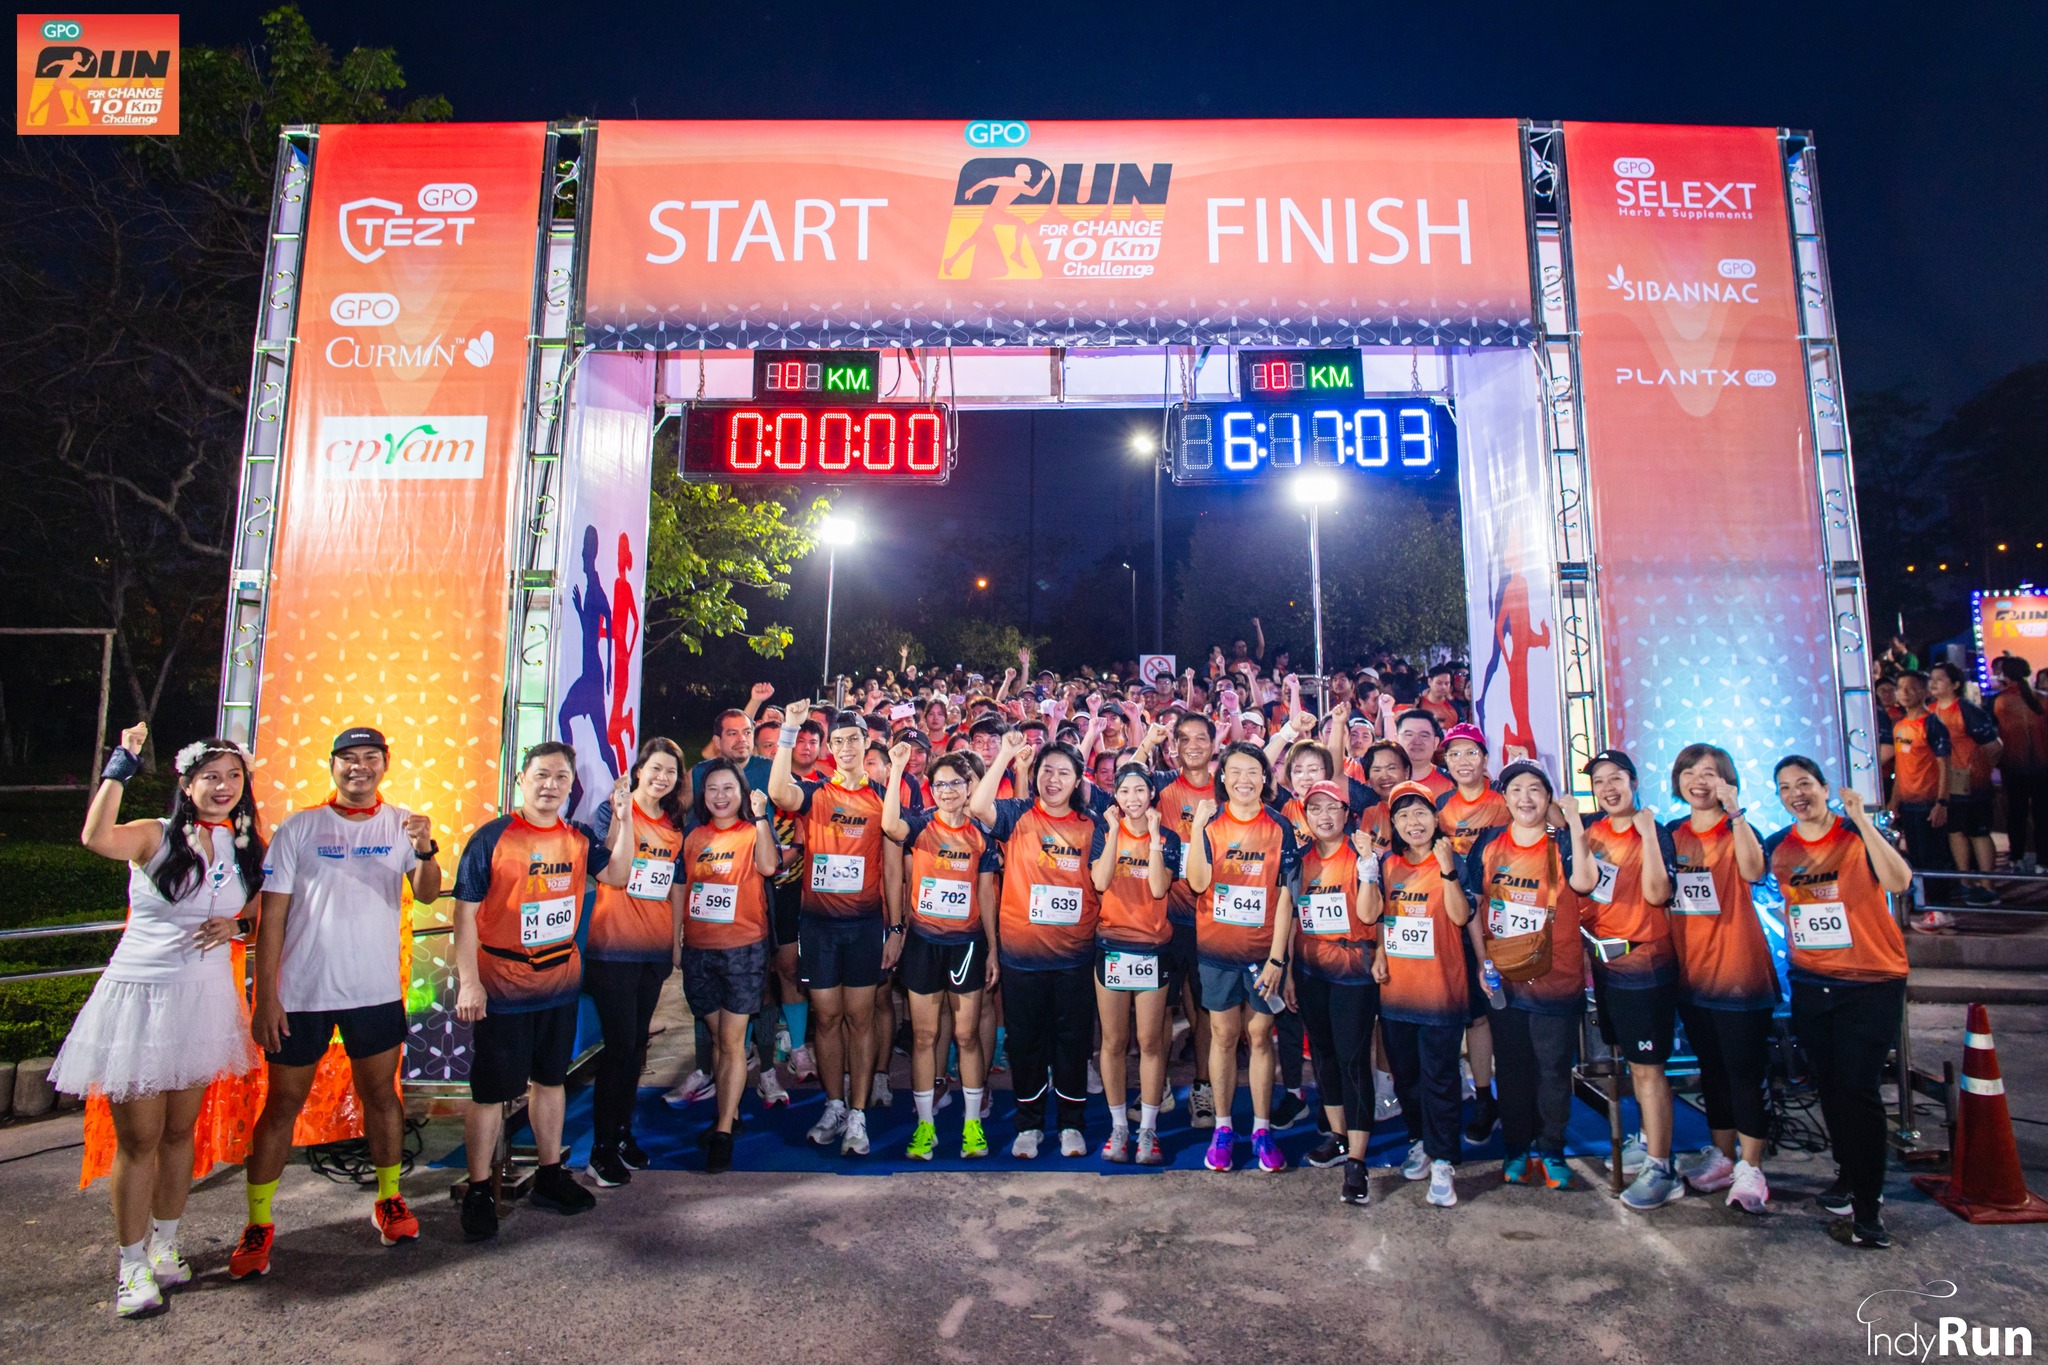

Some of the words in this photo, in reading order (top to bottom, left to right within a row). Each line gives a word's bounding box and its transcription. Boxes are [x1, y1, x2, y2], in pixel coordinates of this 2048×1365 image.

[969, 123, 1025, 144] GPO
[1617, 161, 1651, 174] GPO
[422, 188, 473, 206] GPO
[1616, 179, 1756, 209] SELEXT
[1619, 207, 1651, 217] Herb
[1658, 209, 1666, 218] &
[1672, 208, 1753, 220] Supplements
[356, 217, 475, 246] TEZT
[646, 198, 888, 264] START
[1039, 224, 1068, 236] FOR
[1072, 220, 1164, 236] CHANGE
[1207, 197, 1471, 264] FINISH
[1042, 237, 1097, 261] 10
[1110, 241, 1158, 257] Km
[1063, 262, 1154, 278] Challenge
[1721, 263, 1753, 275] GPO
[1623, 280, 1759, 303] SIBANNAC
[336, 299, 394, 320] GPO
[1616, 368, 1741, 386] PLANTX
[1748, 373, 1774, 383] GPO
[730, 412, 941, 470] 0:00:00
[1223, 409, 1433, 470] 6:17:03
[816, 865, 827, 875] M
[635, 870, 644, 879] F
[650, 872, 670, 886] 520
[813, 878, 825, 886] 31
[629, 882, 642, 892] 41
[1684, 885, 1711, 898] 678
[694, 893, 700, 903] F
[706, 895, 731, 908] 596
[924, 888, 932, 898] F
[941, 891, 966, 904] 702
[1218, 895, 1226, 904] F
[1233, 897, 1261, 911] 644
[691, 906, 700, 915] 46
[920, 901, 932, 910] 56
[1051, 897, 1077, 911] 639
[526, 915, 539, 927] M
[546, 909, 571, 926] 660
[1031, 908, 1043, 918] 51
[1215, 907, 1226, 917] 51
[1302, 907, 1309, 916] F
[1316, 905, 1342, 918] 710
[1302, 919, 1313, 928] 56
[1493, 911, 1501, 921] F
[1510, 915, 1537, 930] 731
[1793, 918, 1800, 928] F
[1809, 917, 1842, 931] 650
[524, 929, 537, 940] 51
[1387, 928, 1394, 937] F
[1402, 929, 1428, 942] 697
[1490, 924, 1504, 934] 56
[1794, 932, 1806, 942] 51
[1386, 941, 1397, 950] 56
[1110, 962, 1118, 972] F
[1127, 963, 1153, 976] 166
[1107, 975, 1120, 984] 26
